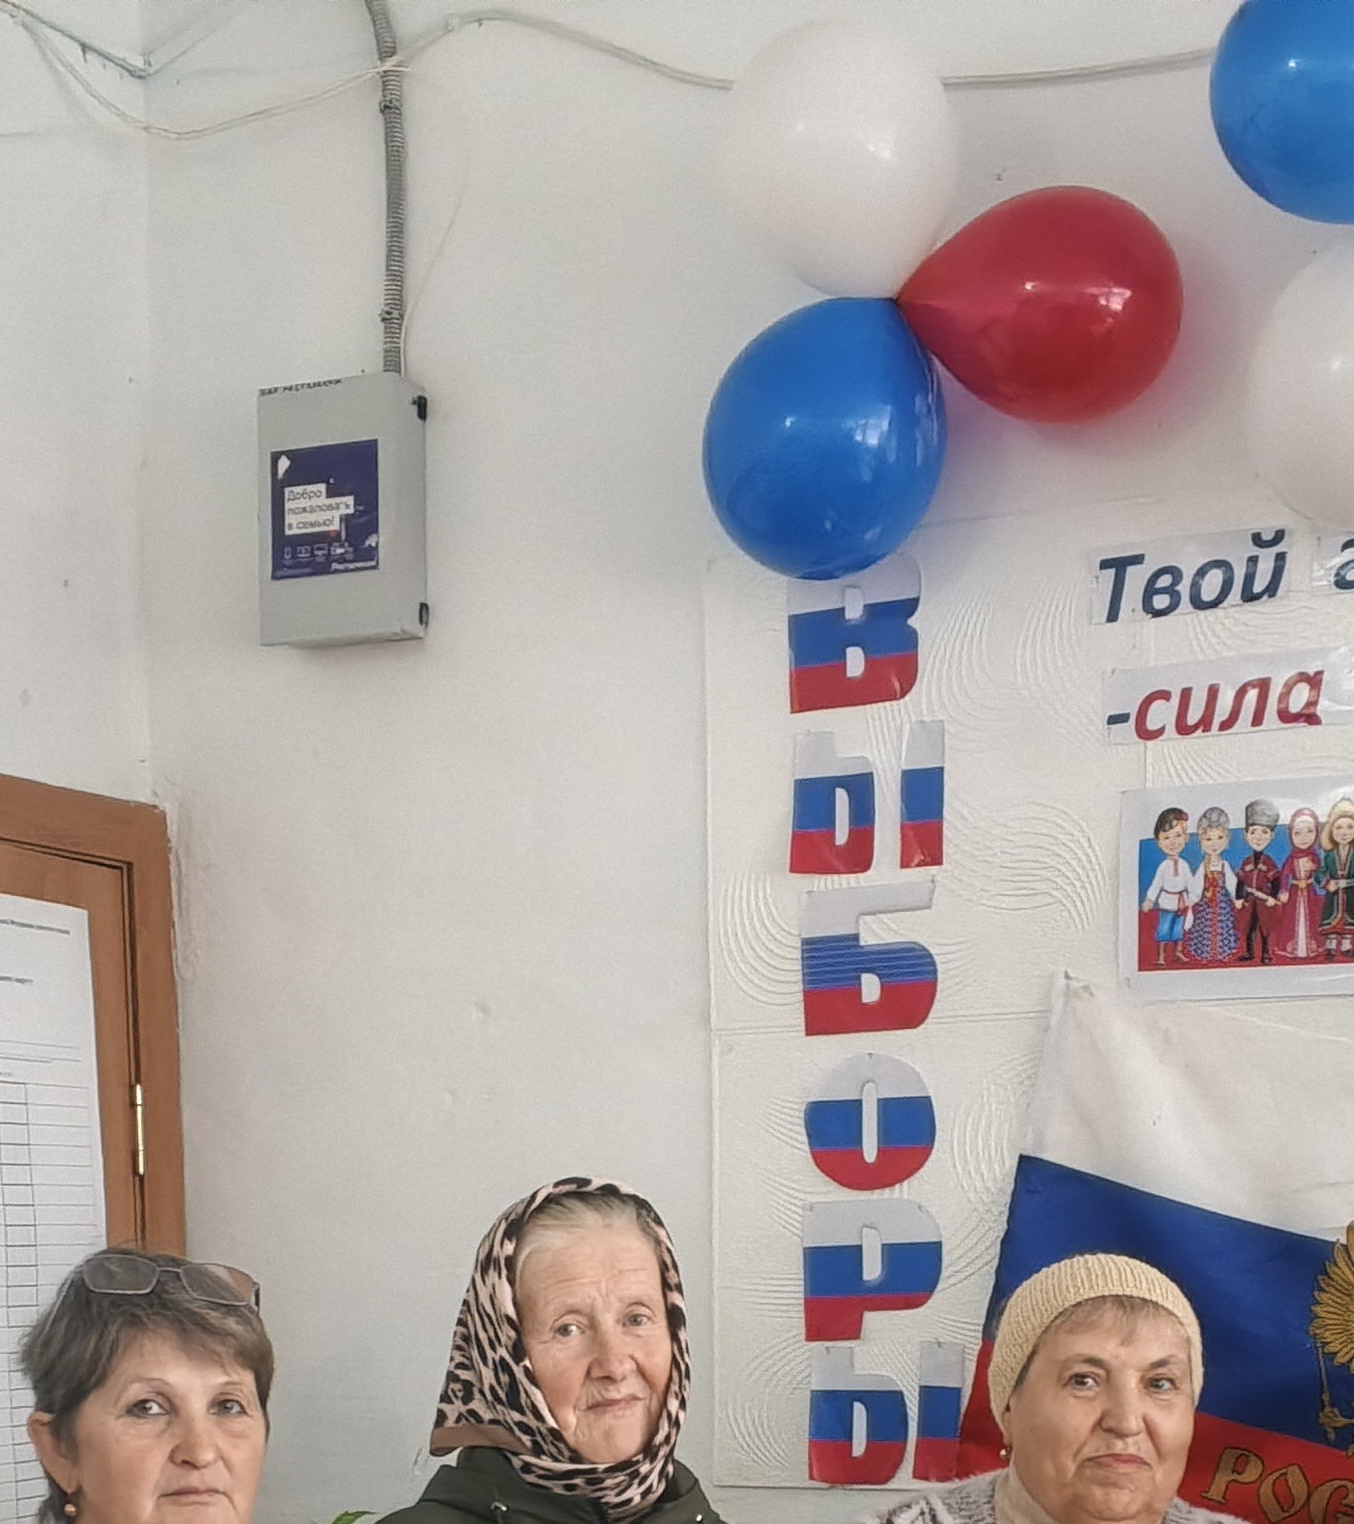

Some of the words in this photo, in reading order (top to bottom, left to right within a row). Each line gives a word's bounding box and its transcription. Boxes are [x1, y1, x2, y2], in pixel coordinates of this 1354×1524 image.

[287, 489, 323, 502] Добро
[287, 501, 351, 516] пожаловать
[296, 515, 335, 530] семью!
[1098, 527, 1288, 623] Твой
[1106, 669, 1325, 741] -сила
[788, 555, 963, 1485] ВЫБОРЫ
